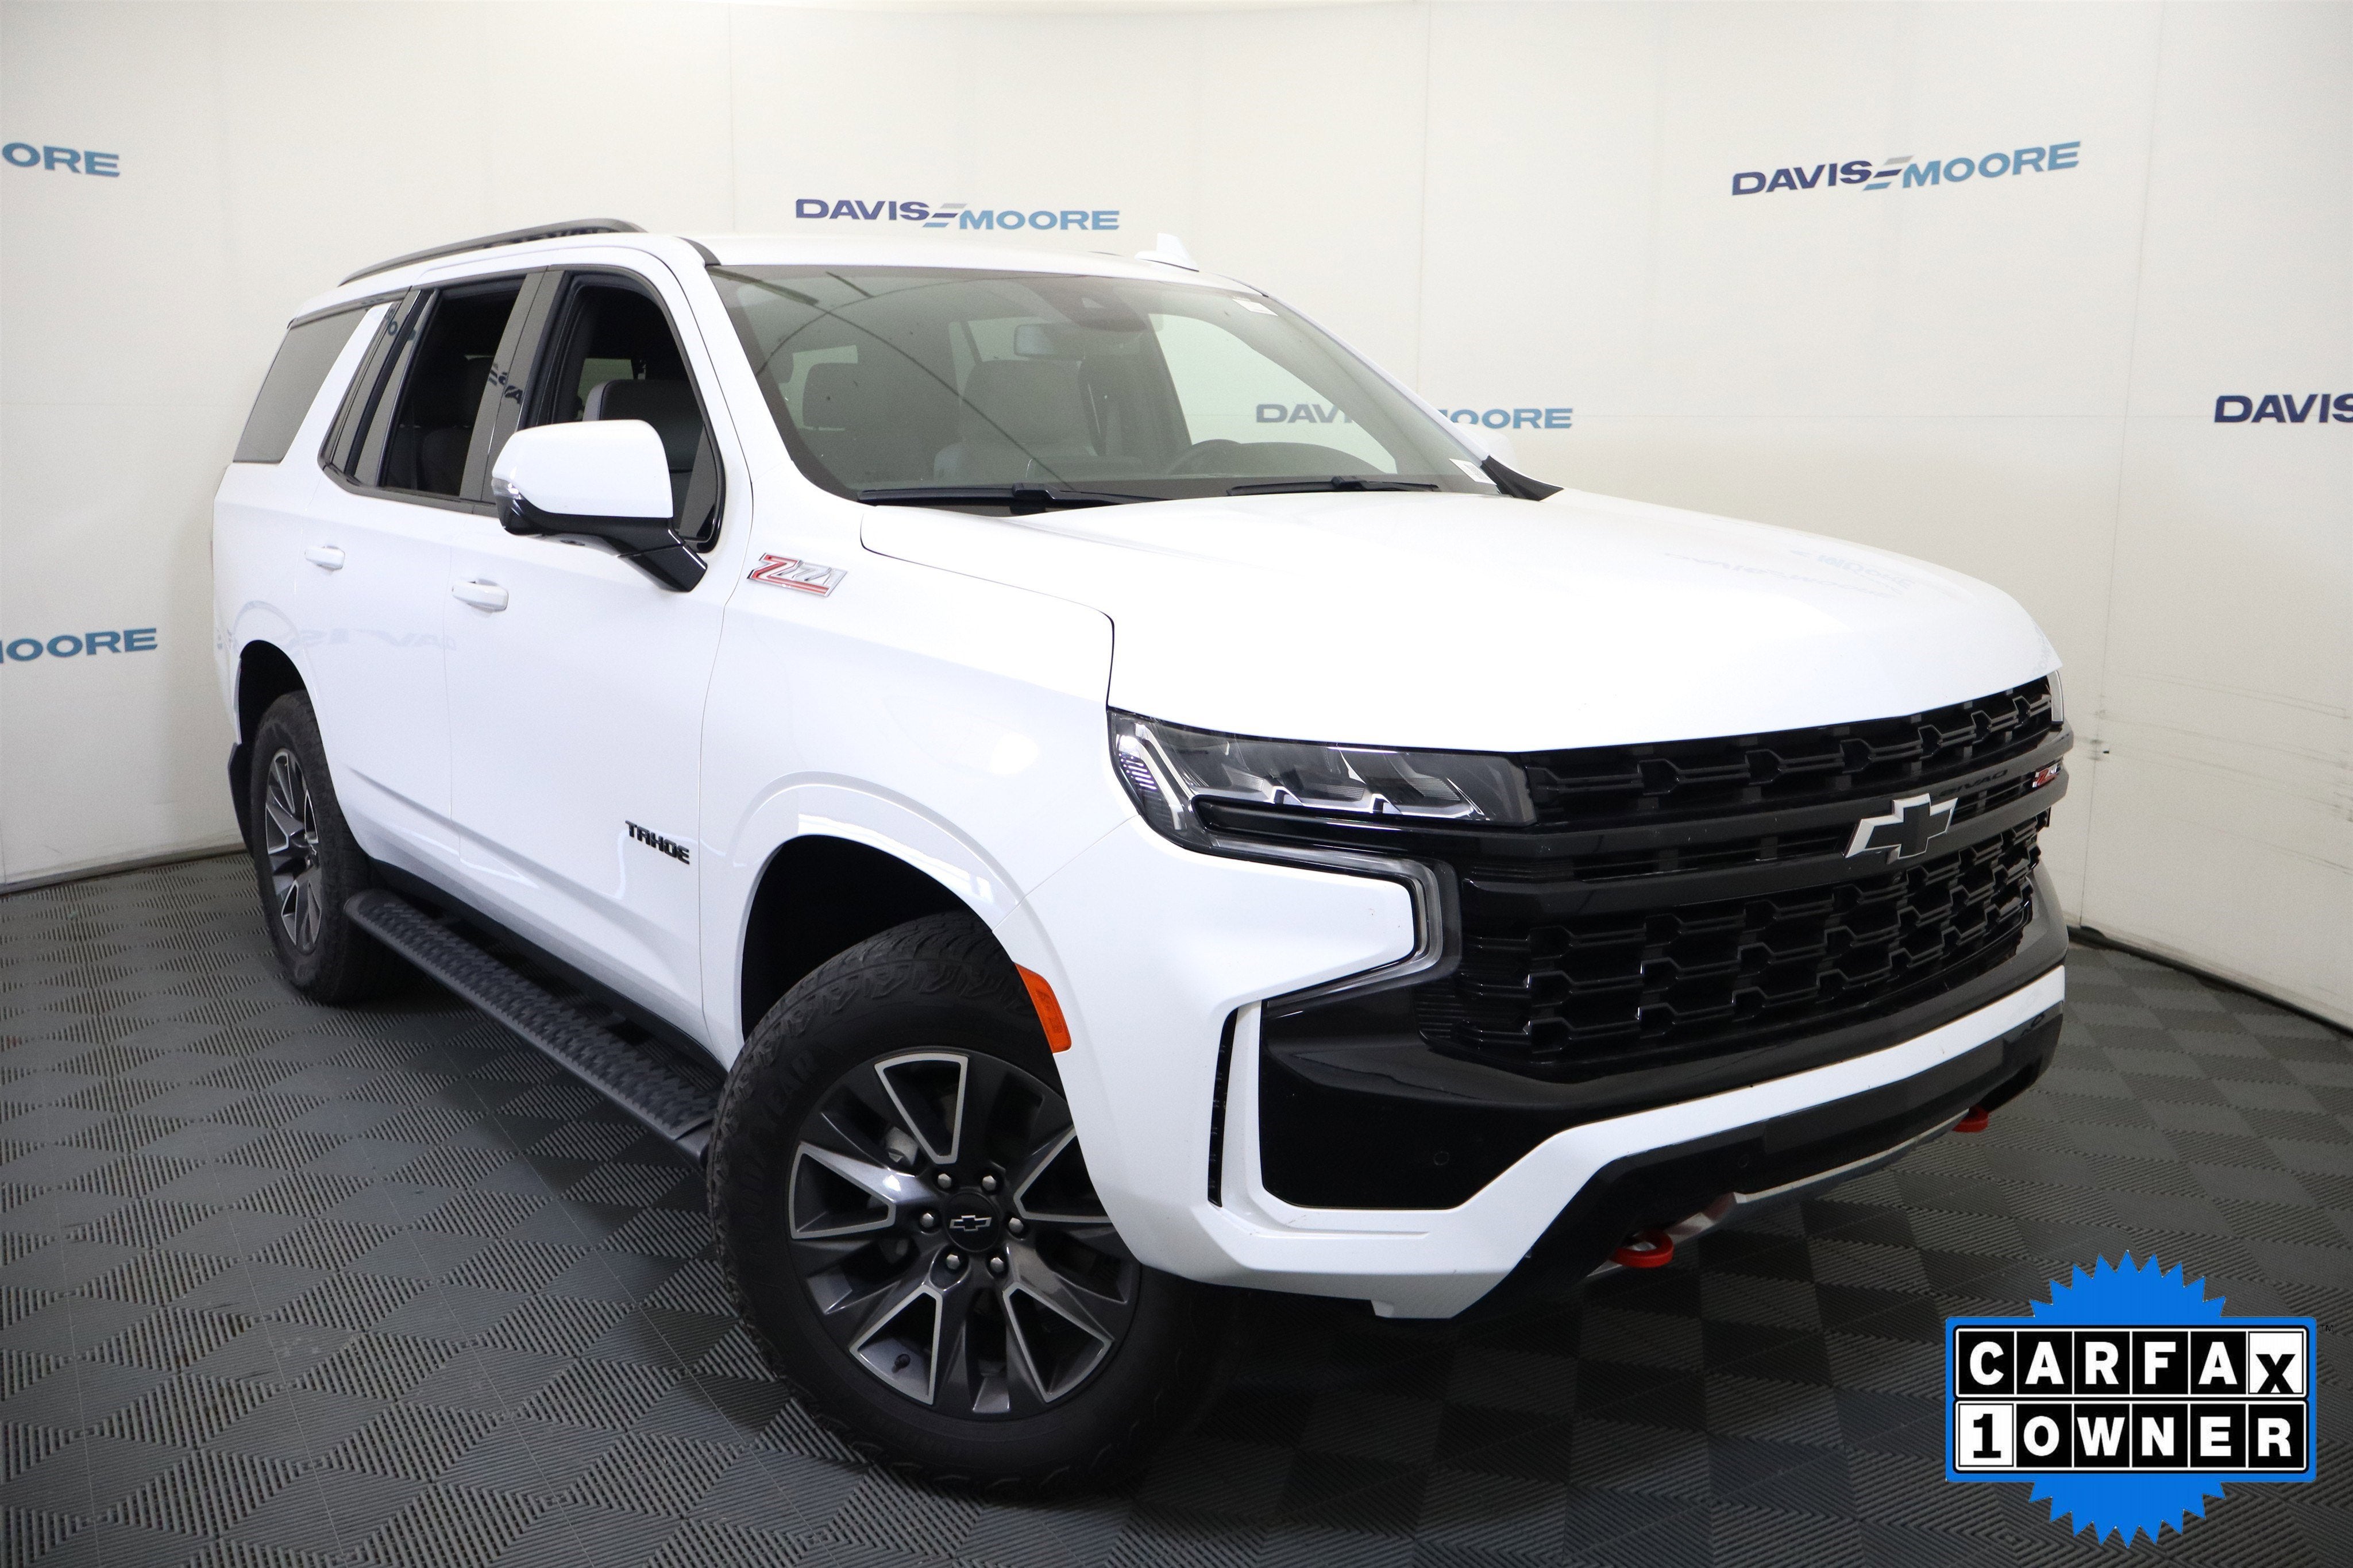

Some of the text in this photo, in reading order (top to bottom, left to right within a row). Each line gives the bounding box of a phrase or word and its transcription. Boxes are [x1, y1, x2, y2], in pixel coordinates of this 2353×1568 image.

[1731, 141, 2081, 195] DAVIS MOORE
[796, 199, 1120, 230] DAVIS MOORE
[1256, 404, 1573, 429] DAV OORE
[747, 553, 847, 597] Z71
[0, 628, 157, 664] OORE
[625, 820, 690, 865] TAHOE
